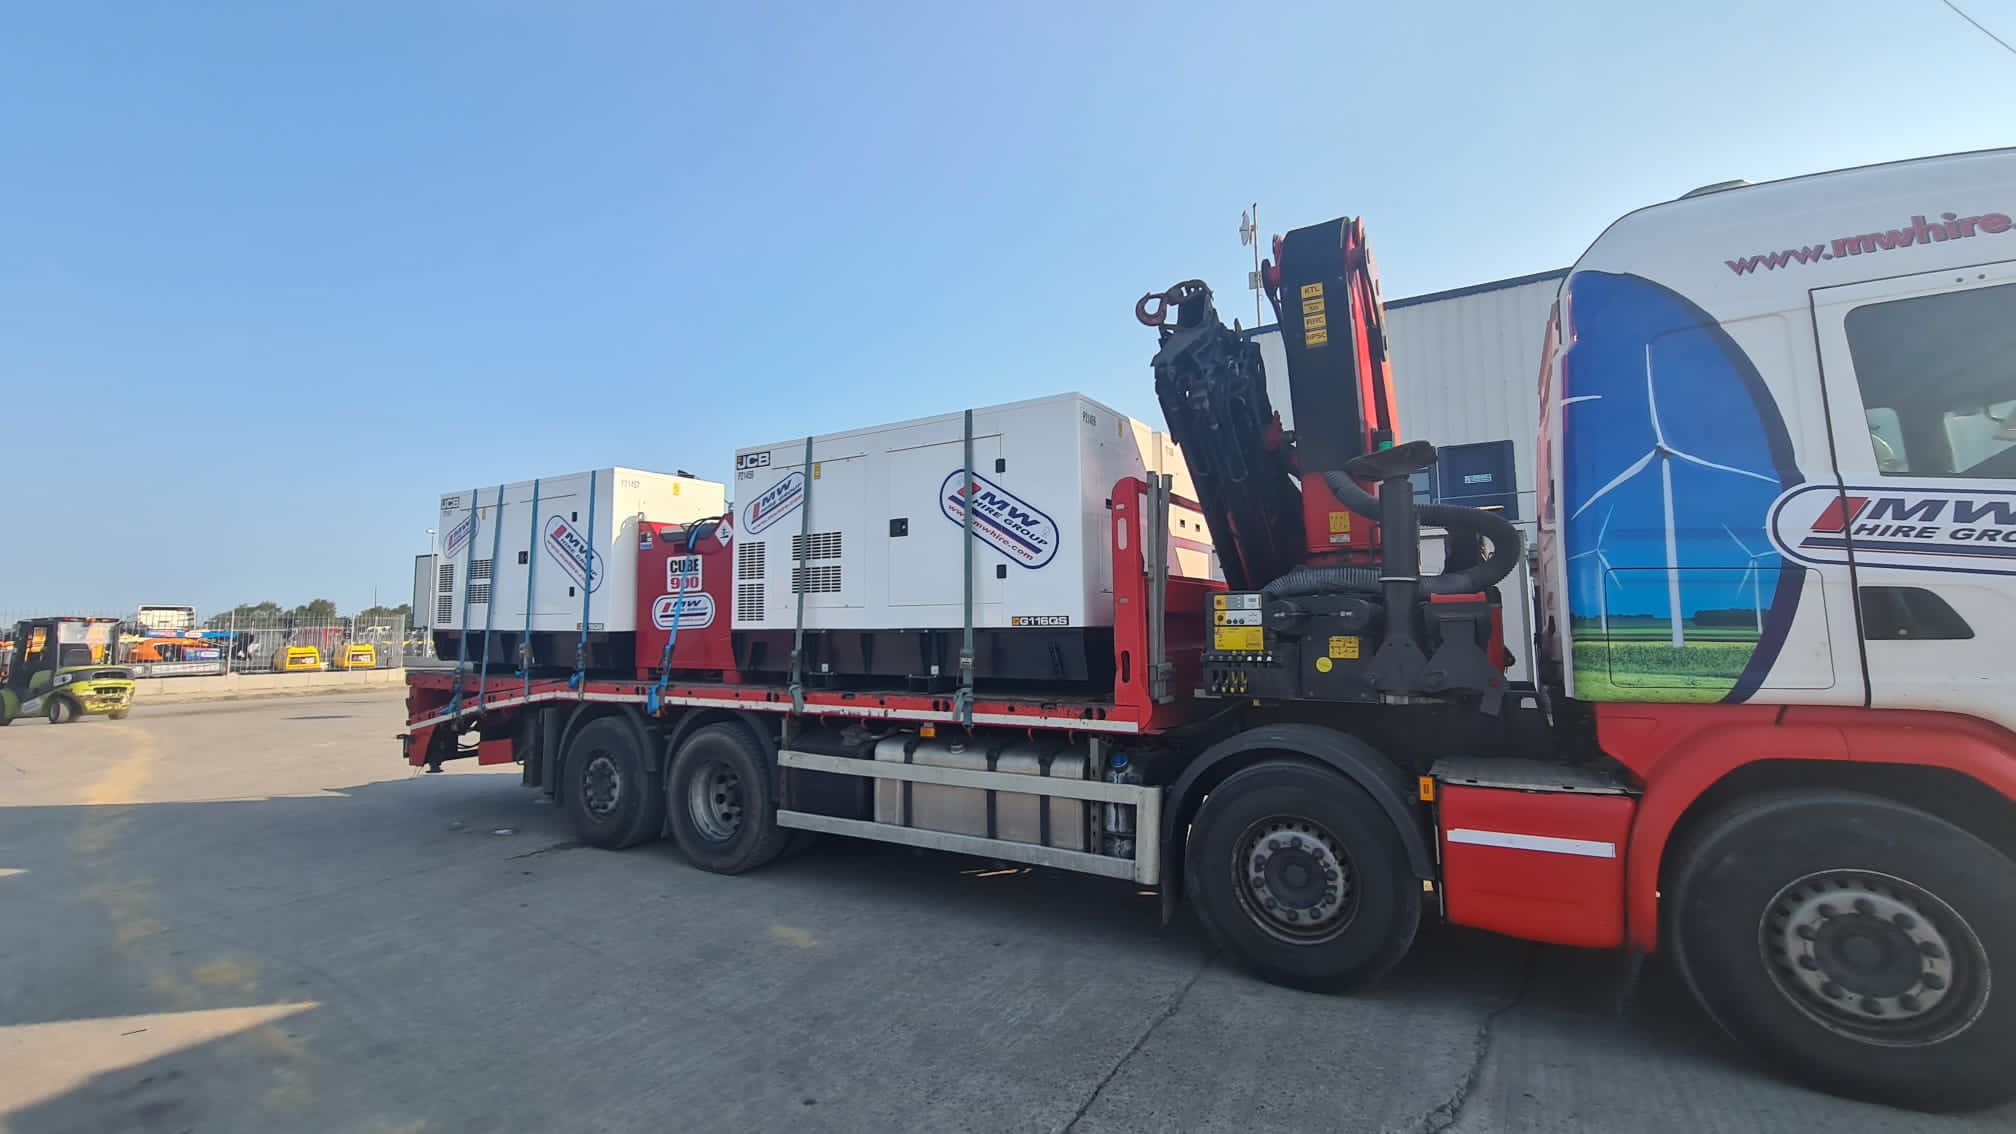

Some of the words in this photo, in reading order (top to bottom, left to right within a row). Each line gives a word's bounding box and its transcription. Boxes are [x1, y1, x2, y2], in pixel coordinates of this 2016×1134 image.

[737, 452, 769, 469] JCB
[761, 479, 793, 507] MW
[972, 499, 1003, 520] HIRE
[1003, 517, 1049, 546] GROUP
[979, 491, 1041, 528] MW
[1865, 497, 2016, 526] MW
[1852, 523, 1941, 540] HIRE
[669, 558, 700, 573] CUBE
